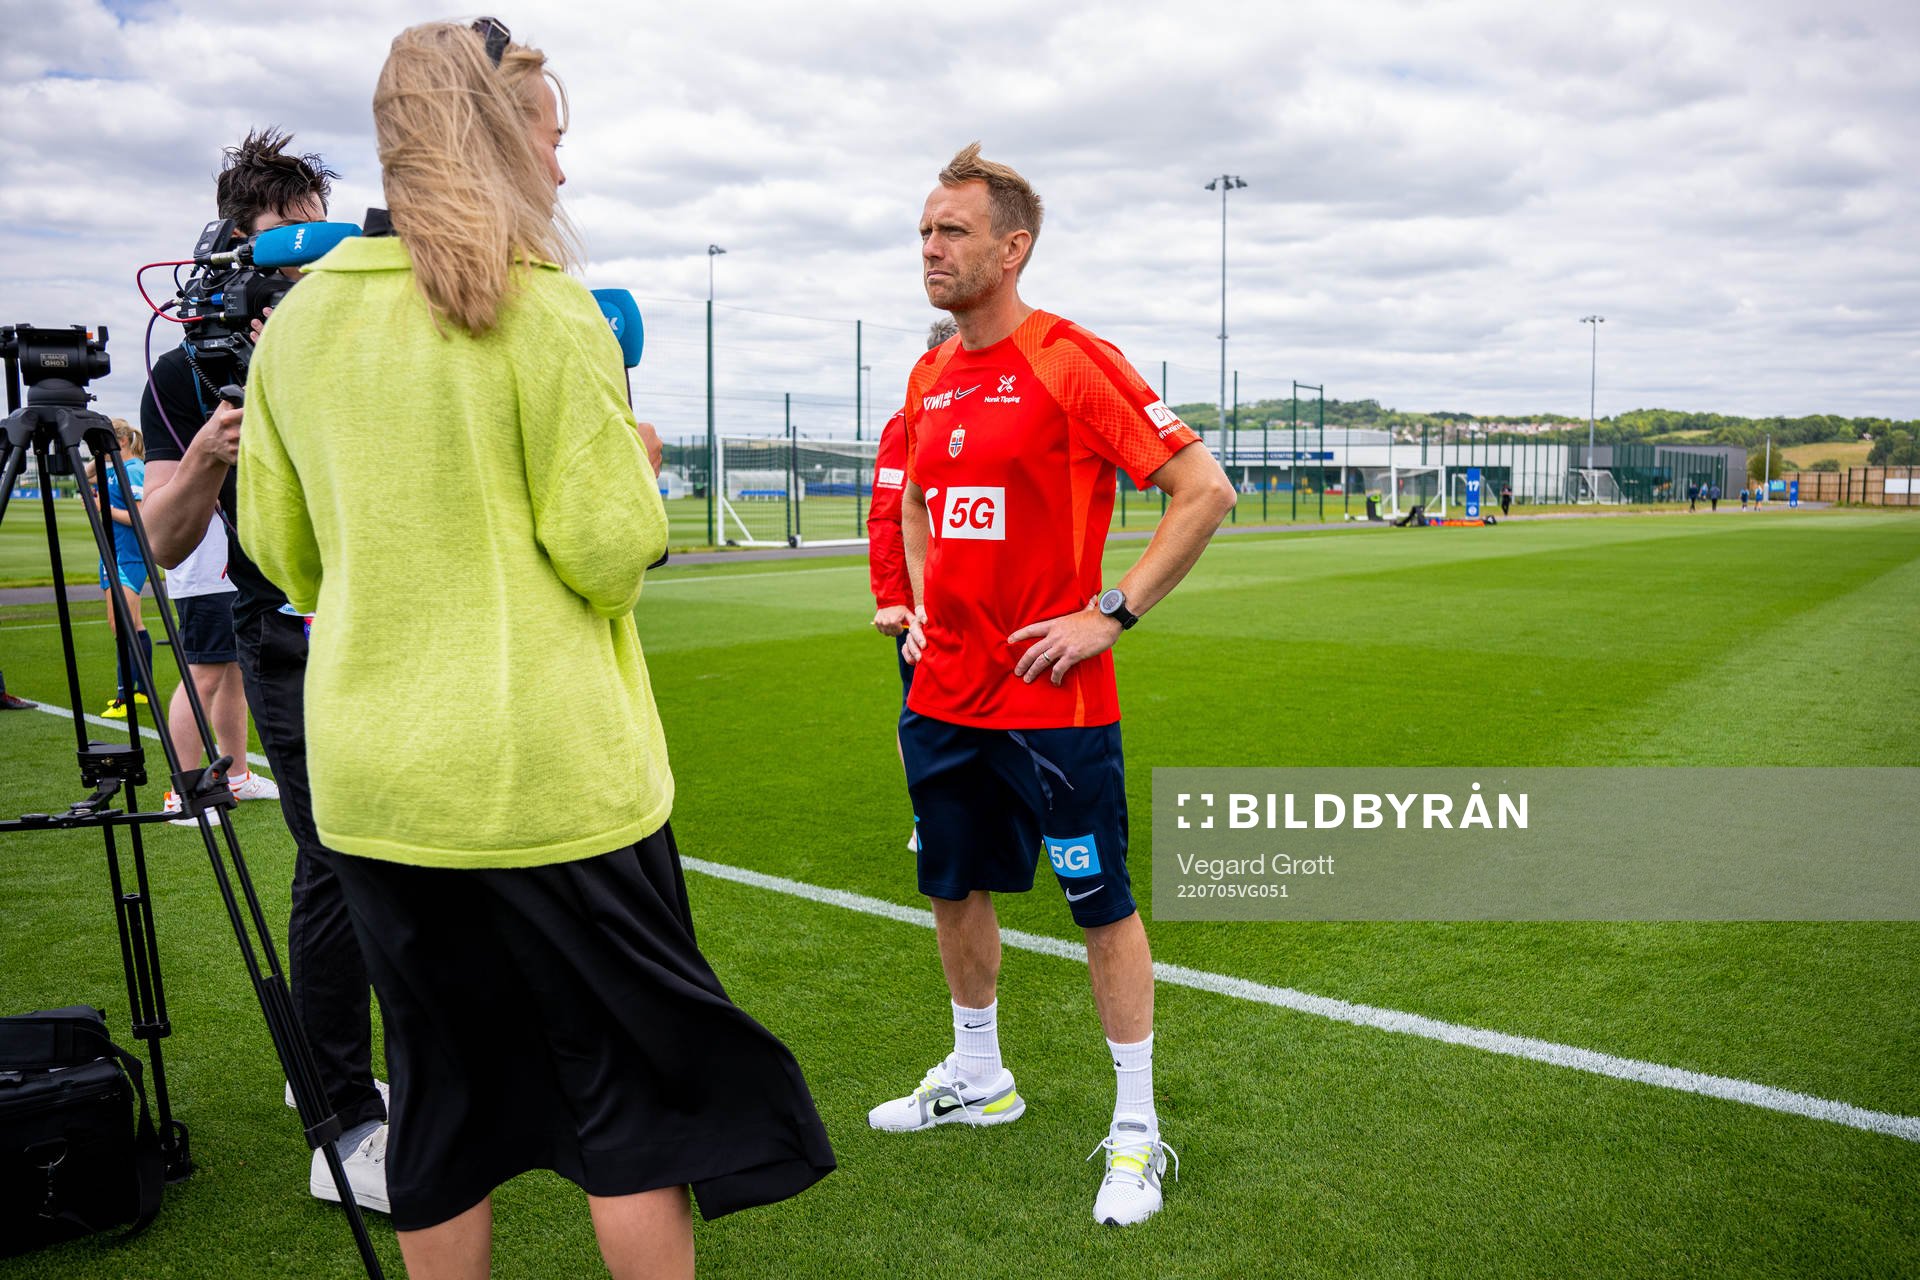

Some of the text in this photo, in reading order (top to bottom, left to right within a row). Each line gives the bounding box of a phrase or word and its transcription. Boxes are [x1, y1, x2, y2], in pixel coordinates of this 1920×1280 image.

[1000, 396, 1021, 404] Tipping
[1468, 480, 1480, 491] 17
[949, 497, 995, 530] 5G
[1050, 845, 1090, 871] 5G
